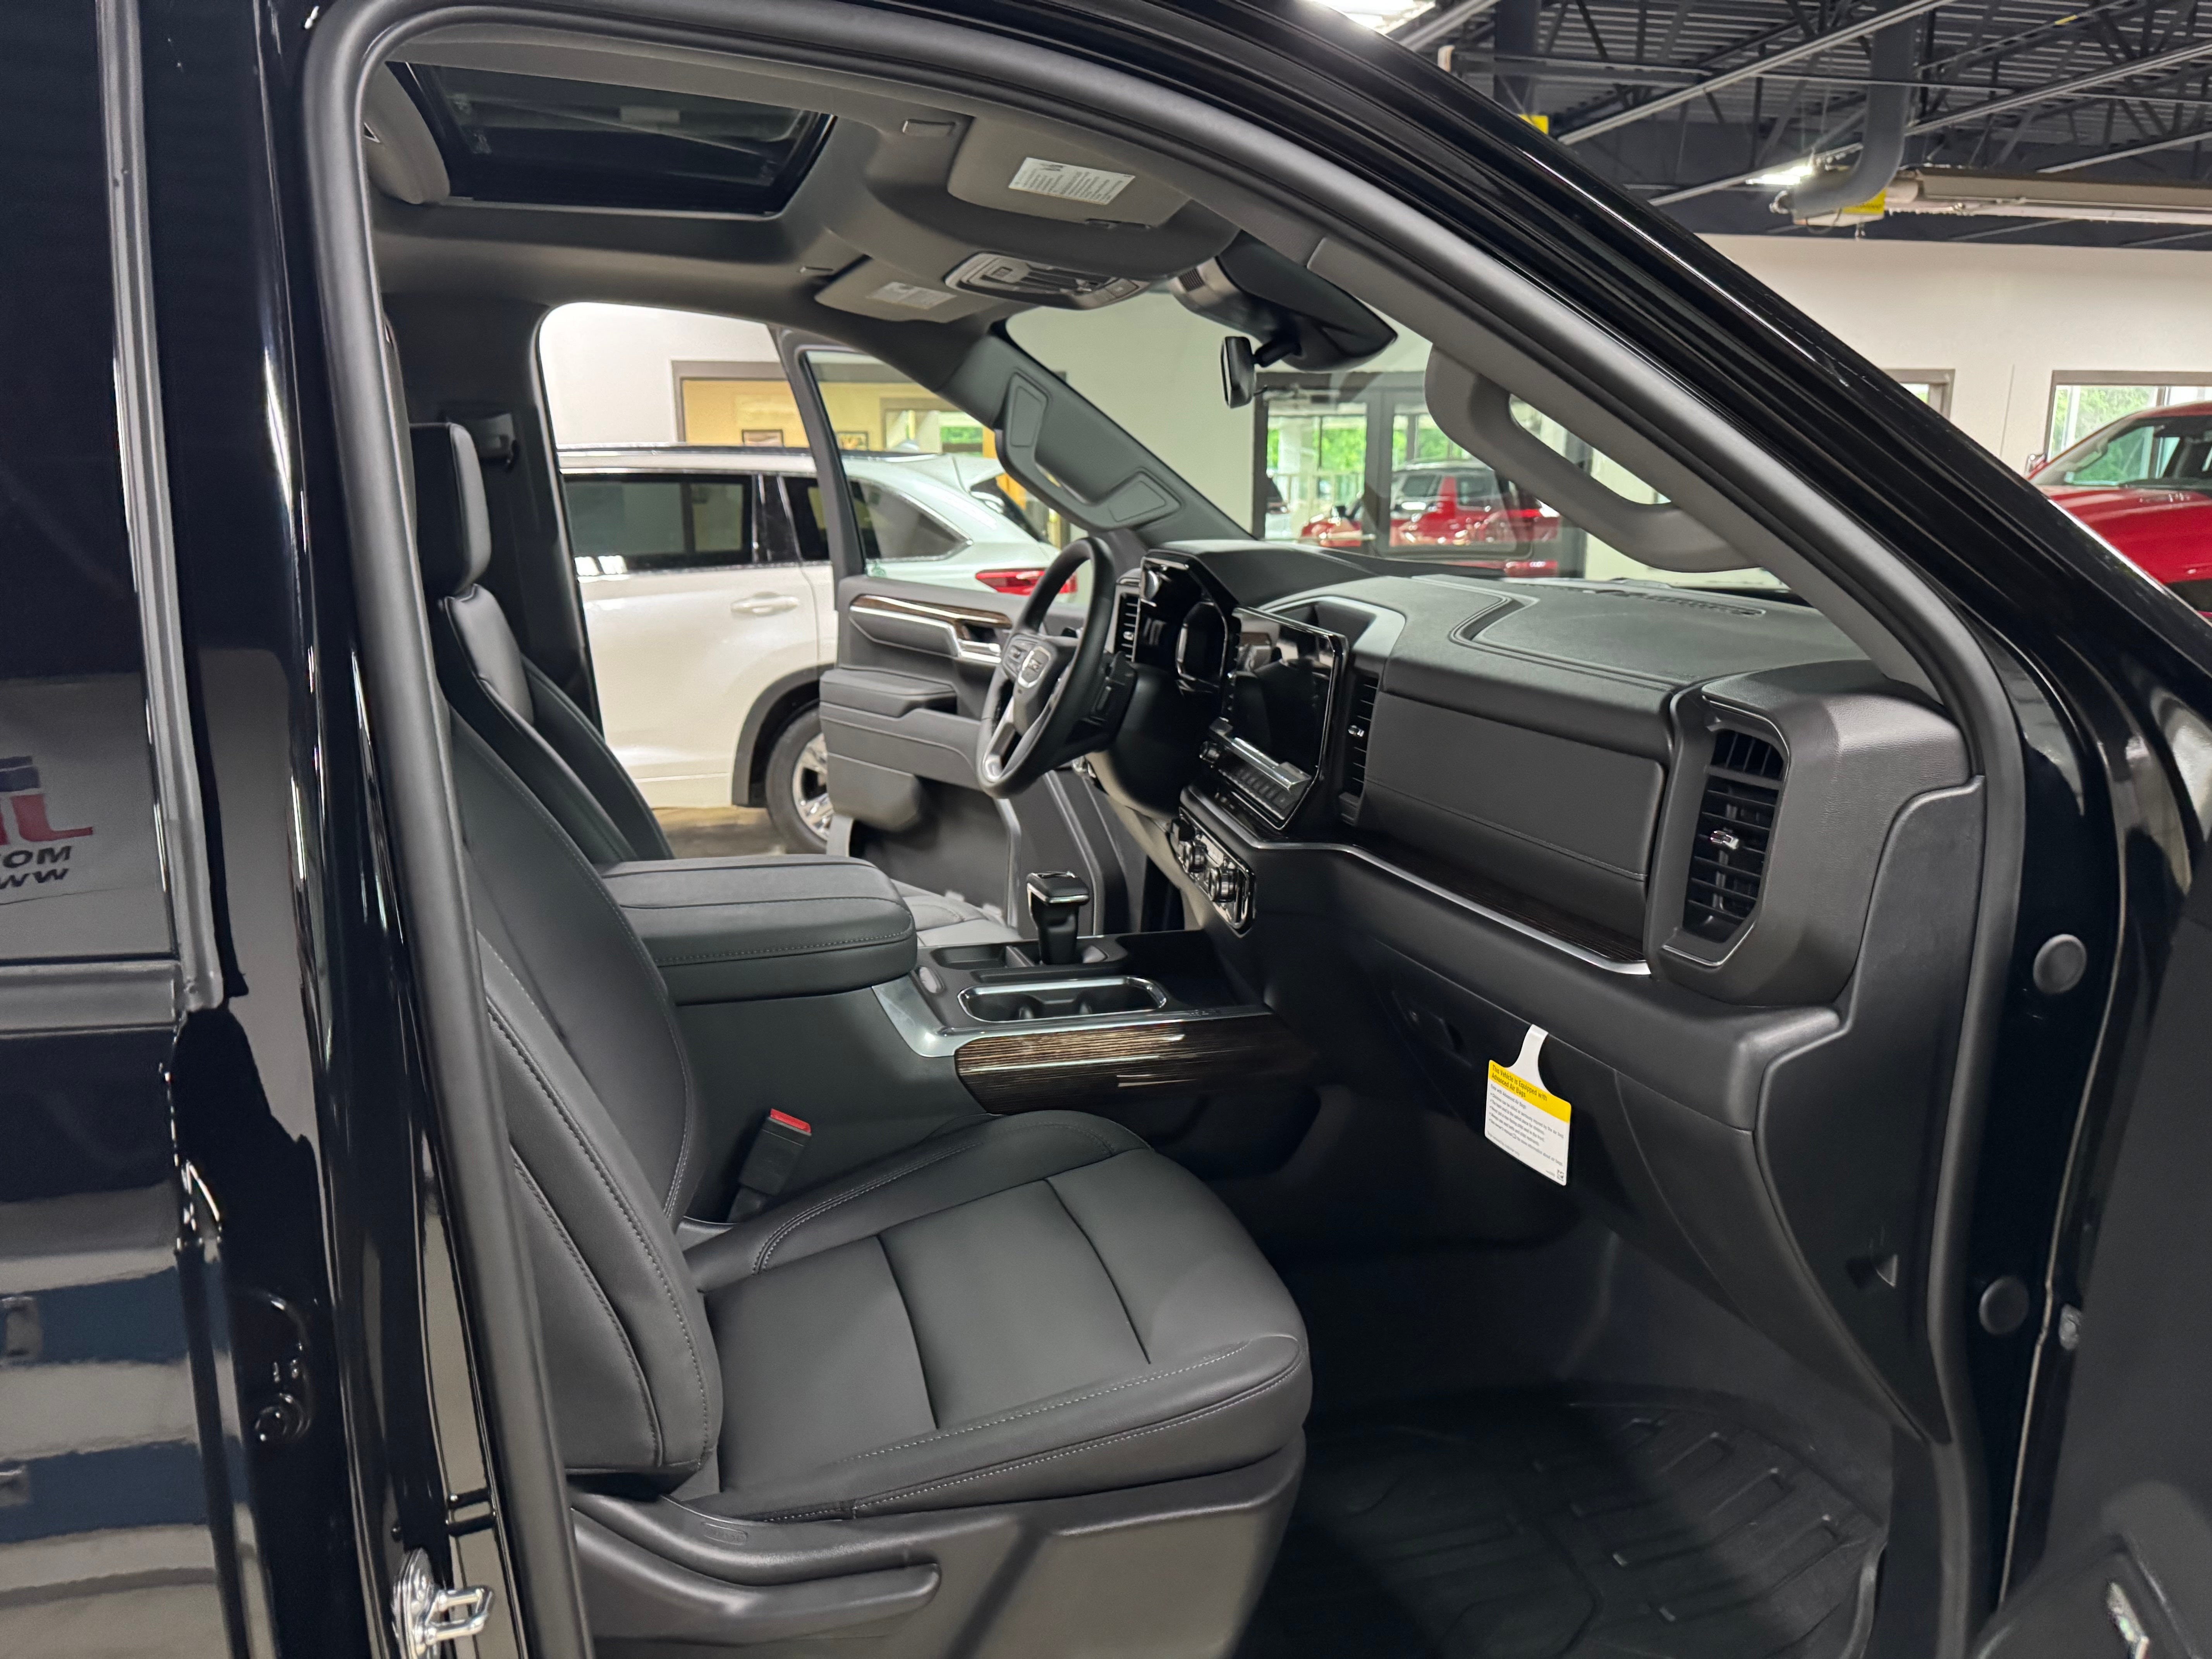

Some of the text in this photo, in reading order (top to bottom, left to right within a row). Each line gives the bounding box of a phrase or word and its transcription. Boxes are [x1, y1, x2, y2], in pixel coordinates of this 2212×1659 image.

[1492, 1072, 1509, 1088] Advanced
[1516, 1087, 1526, 1097] Bags
[1500, 1070, 1514, 1083] Vehicle
[1519, 1080, 1537, 1096] Equipped
[1538, 1092, 1547, 1101] with
